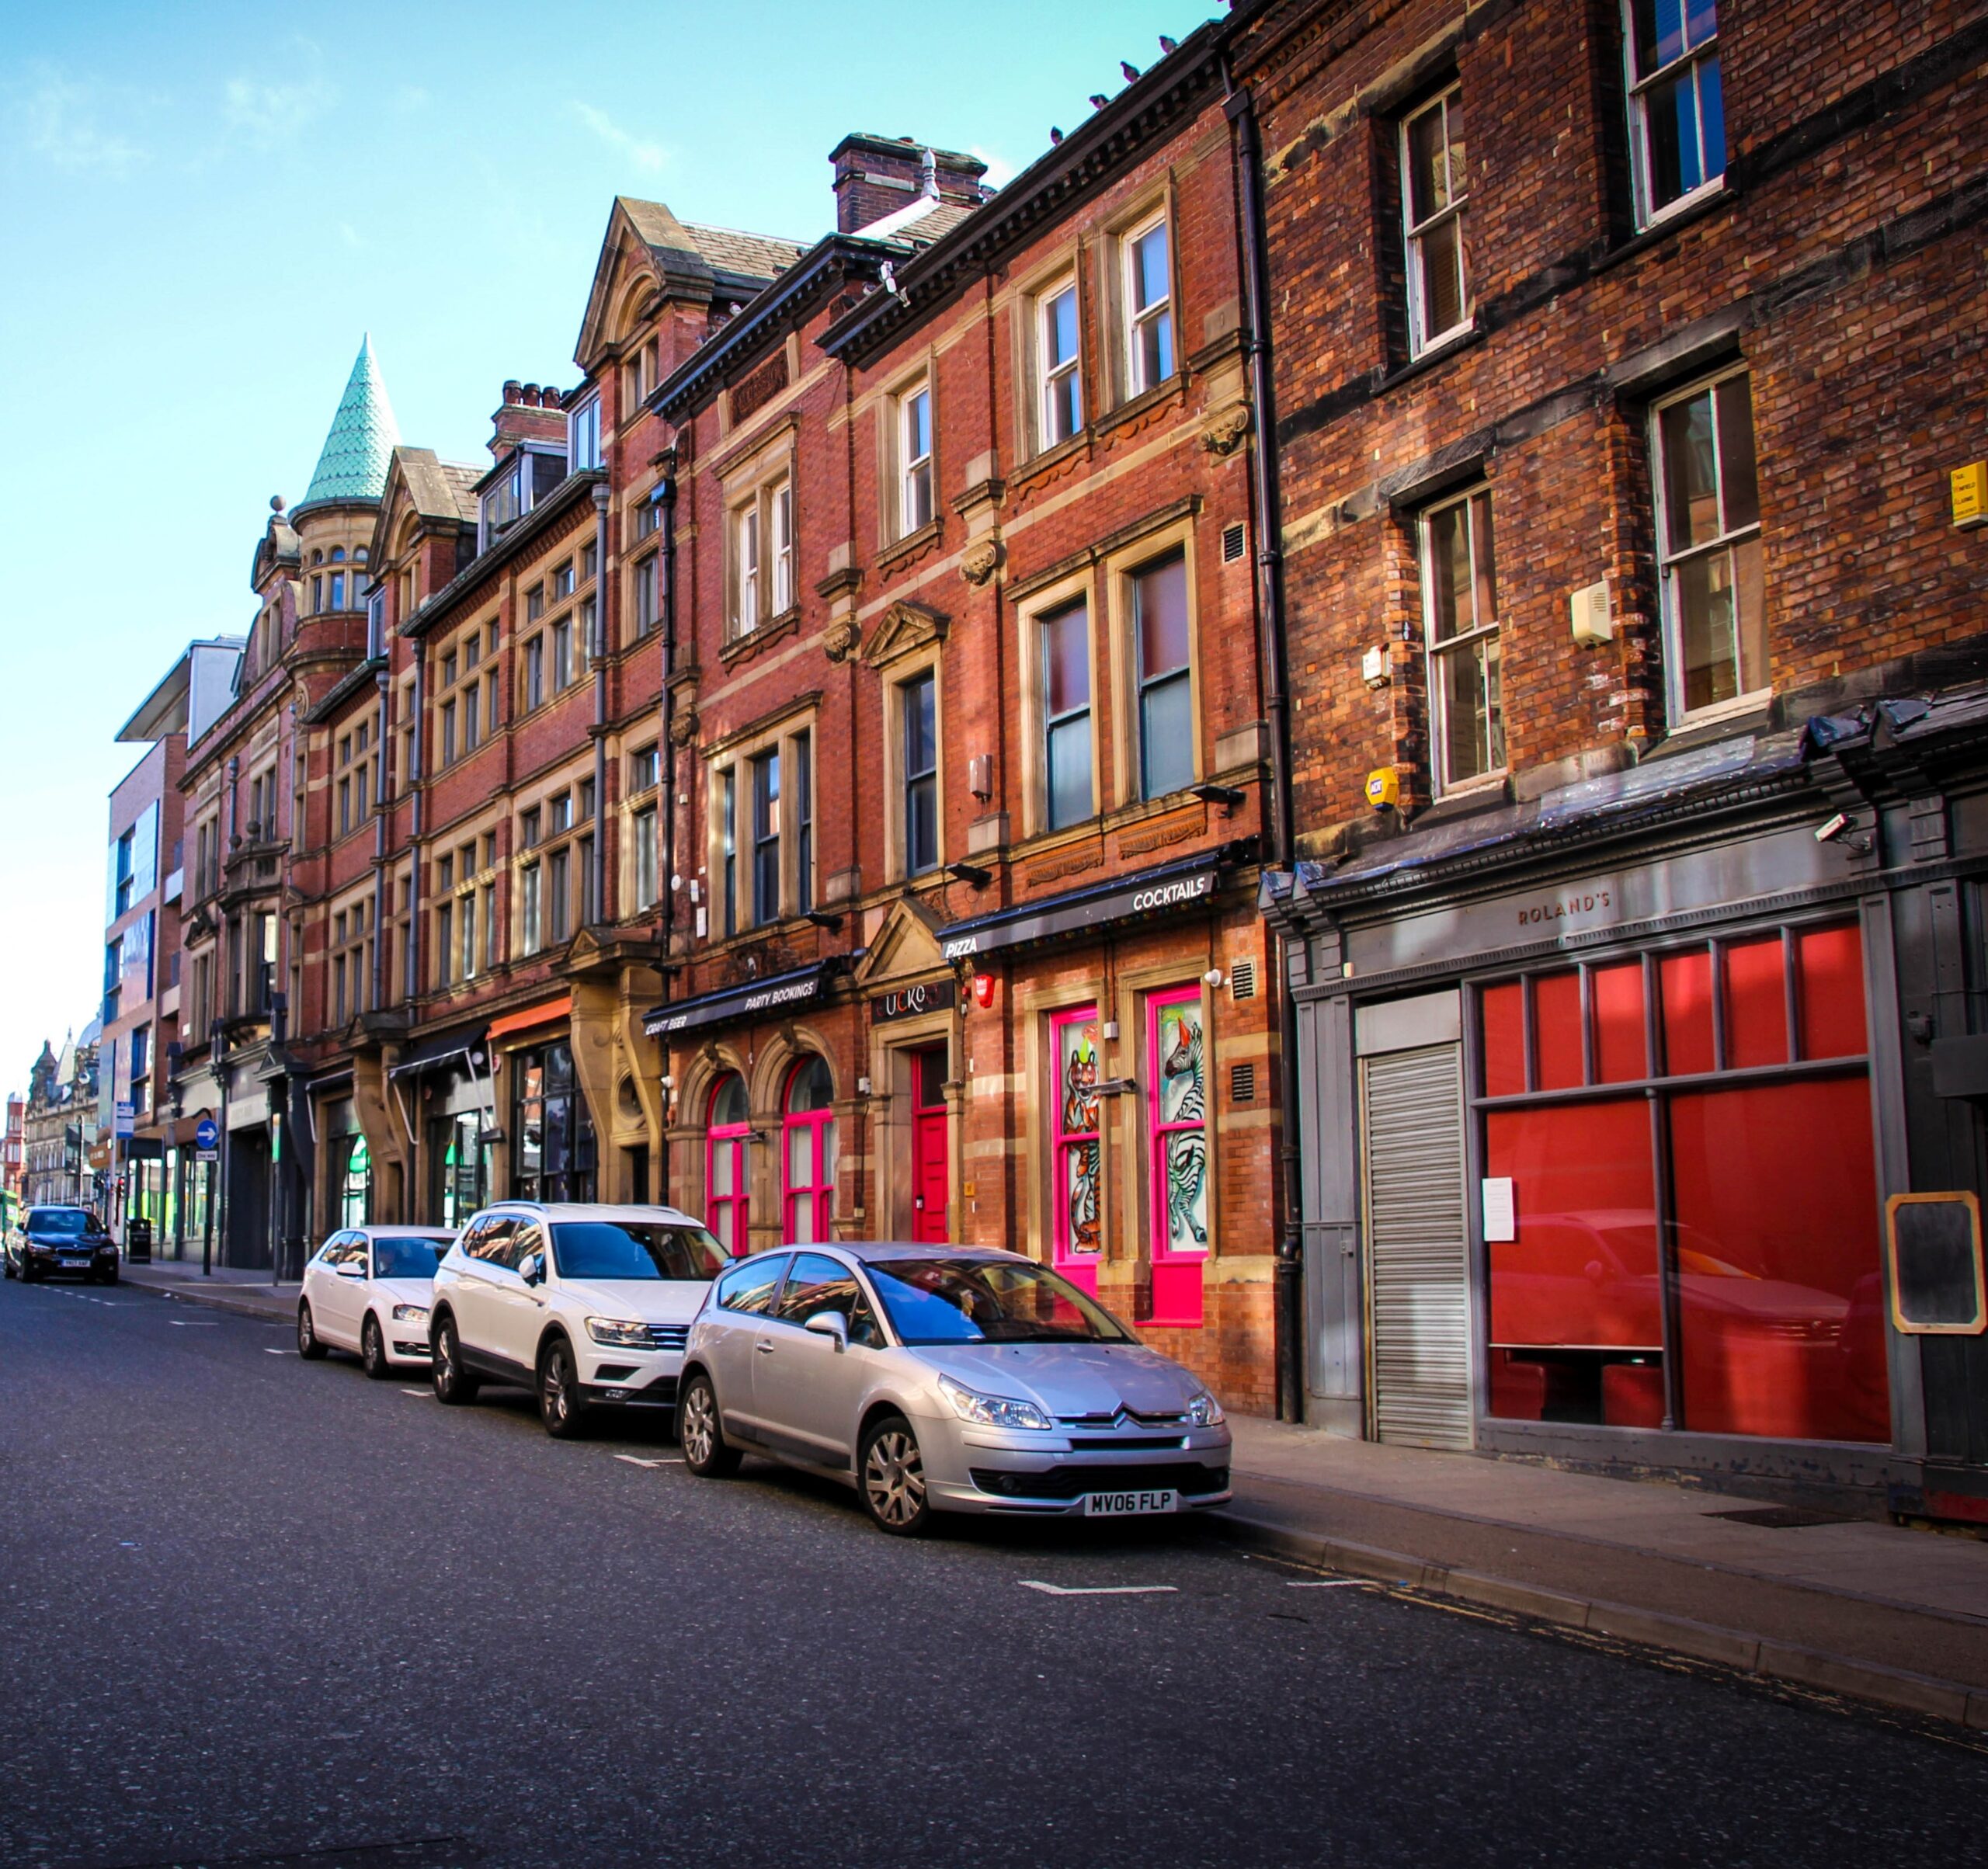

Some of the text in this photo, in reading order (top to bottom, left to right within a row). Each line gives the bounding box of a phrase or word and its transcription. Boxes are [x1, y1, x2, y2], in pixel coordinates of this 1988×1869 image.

[1133, 876, 1205, 911] COCKTAILS
[1518, 891, 1611, 926] ROLAND'S
[945, 937, 978, 958] PIZZA
[745, 981, 815, 1010] PARTY BOOKINGS
[645, 1016, 687, 1036] CRAFT BEER
[1091, 1492, 1171, 1513] MV06 FLP
